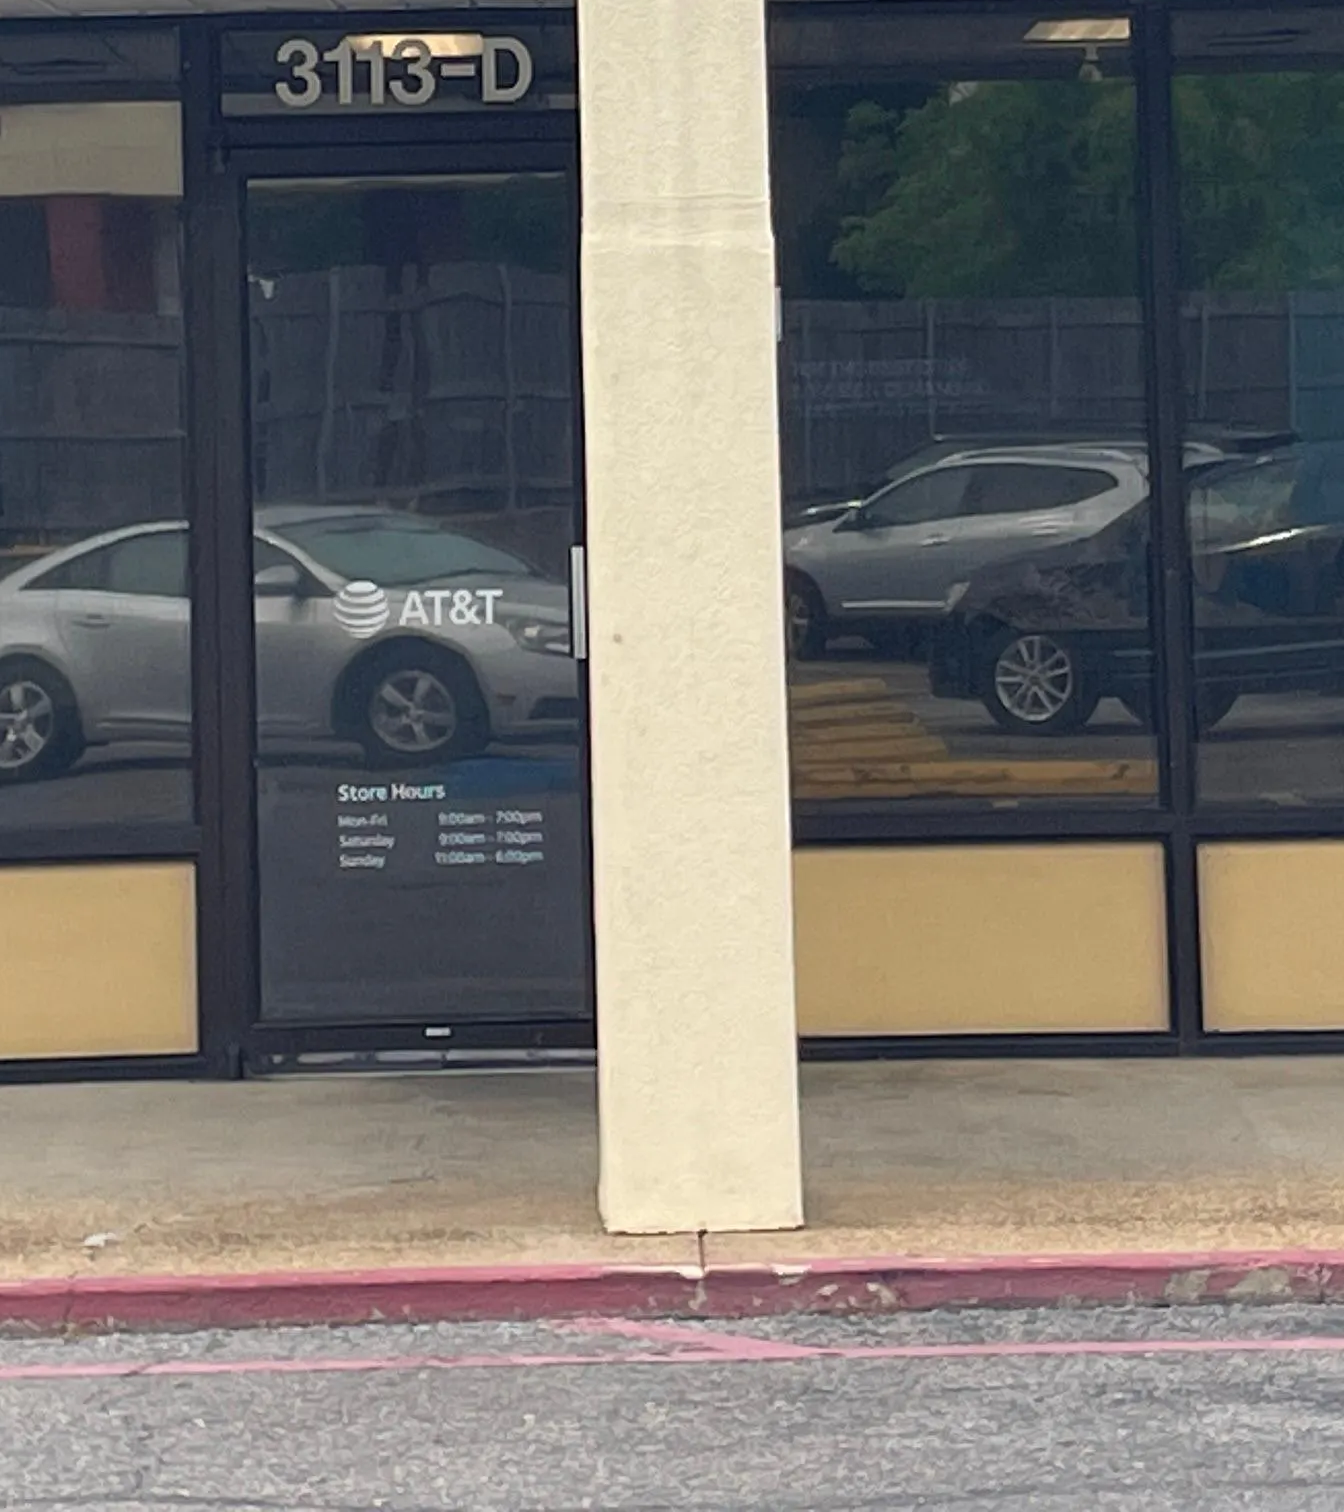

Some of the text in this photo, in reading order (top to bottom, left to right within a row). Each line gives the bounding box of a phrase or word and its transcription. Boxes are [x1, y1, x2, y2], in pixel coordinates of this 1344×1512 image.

[274, 37, 533, 107] 3113-D
[399, 589, 504, 626] AT&T
[338, 783, 446, 801] Store Hours
